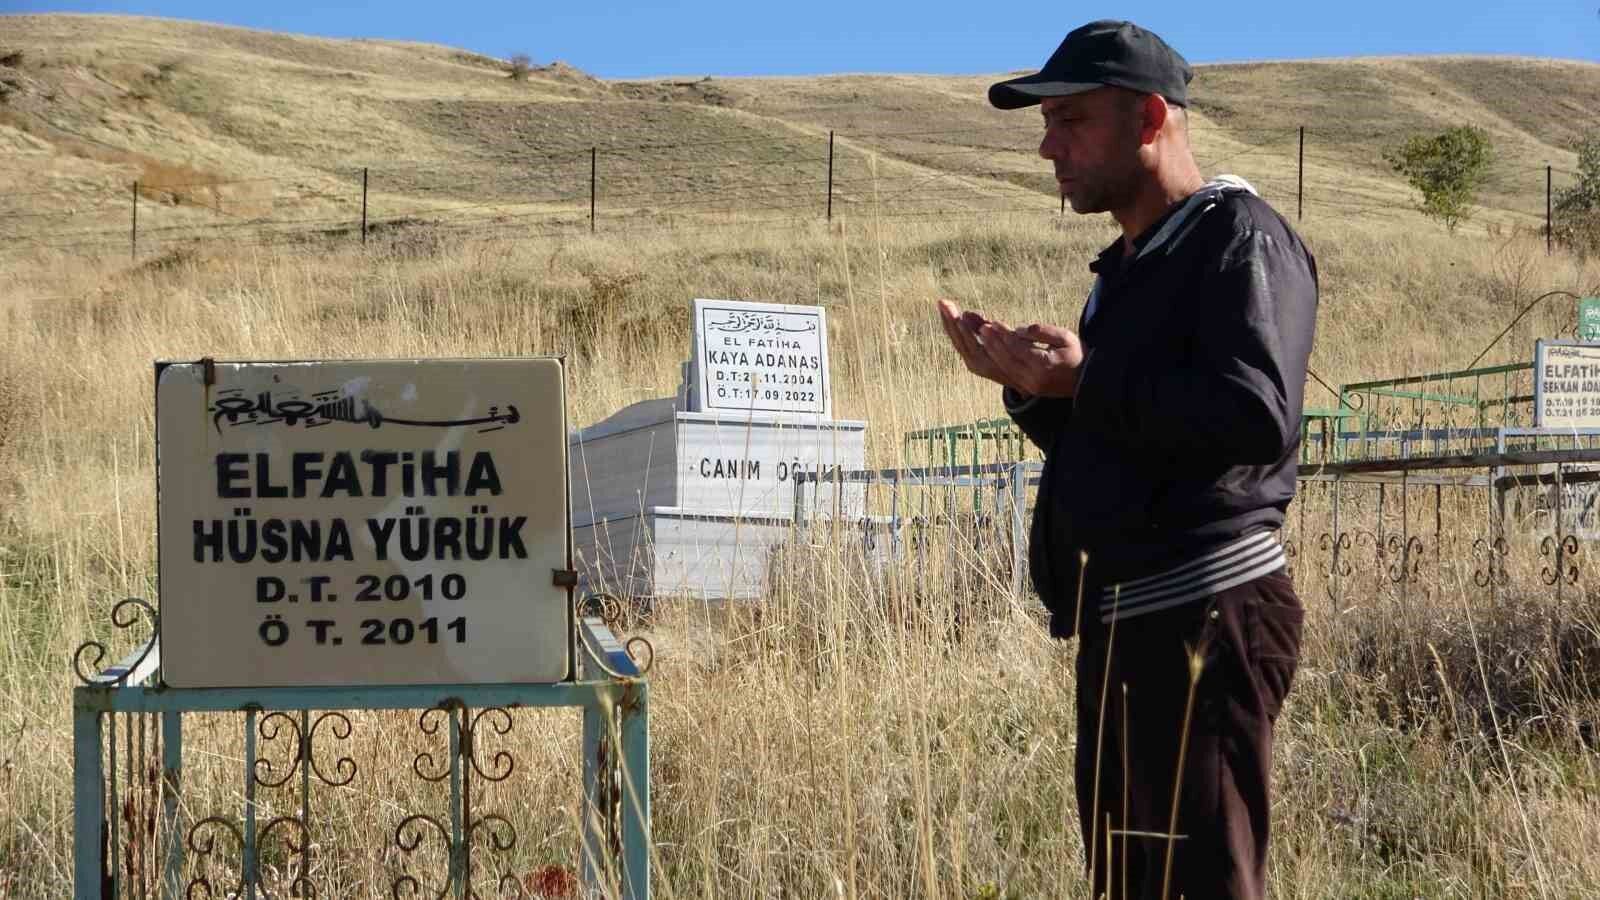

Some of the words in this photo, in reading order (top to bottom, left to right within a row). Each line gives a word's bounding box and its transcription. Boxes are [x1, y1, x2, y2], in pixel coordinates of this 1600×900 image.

[723, 336, 742, 346] EL
[708, 351, 749, 367] KAYA
[716, 371, 813, 385] D.T:2.11.2004
[701, 457, 761, 480] CANIM
[193, 507, 354, 563] HÜSNA
[367, 505, 528, 561] YÜRÜK
[355, 573, 467, 601] 2010
[360, 617, 467, 645] 2011
